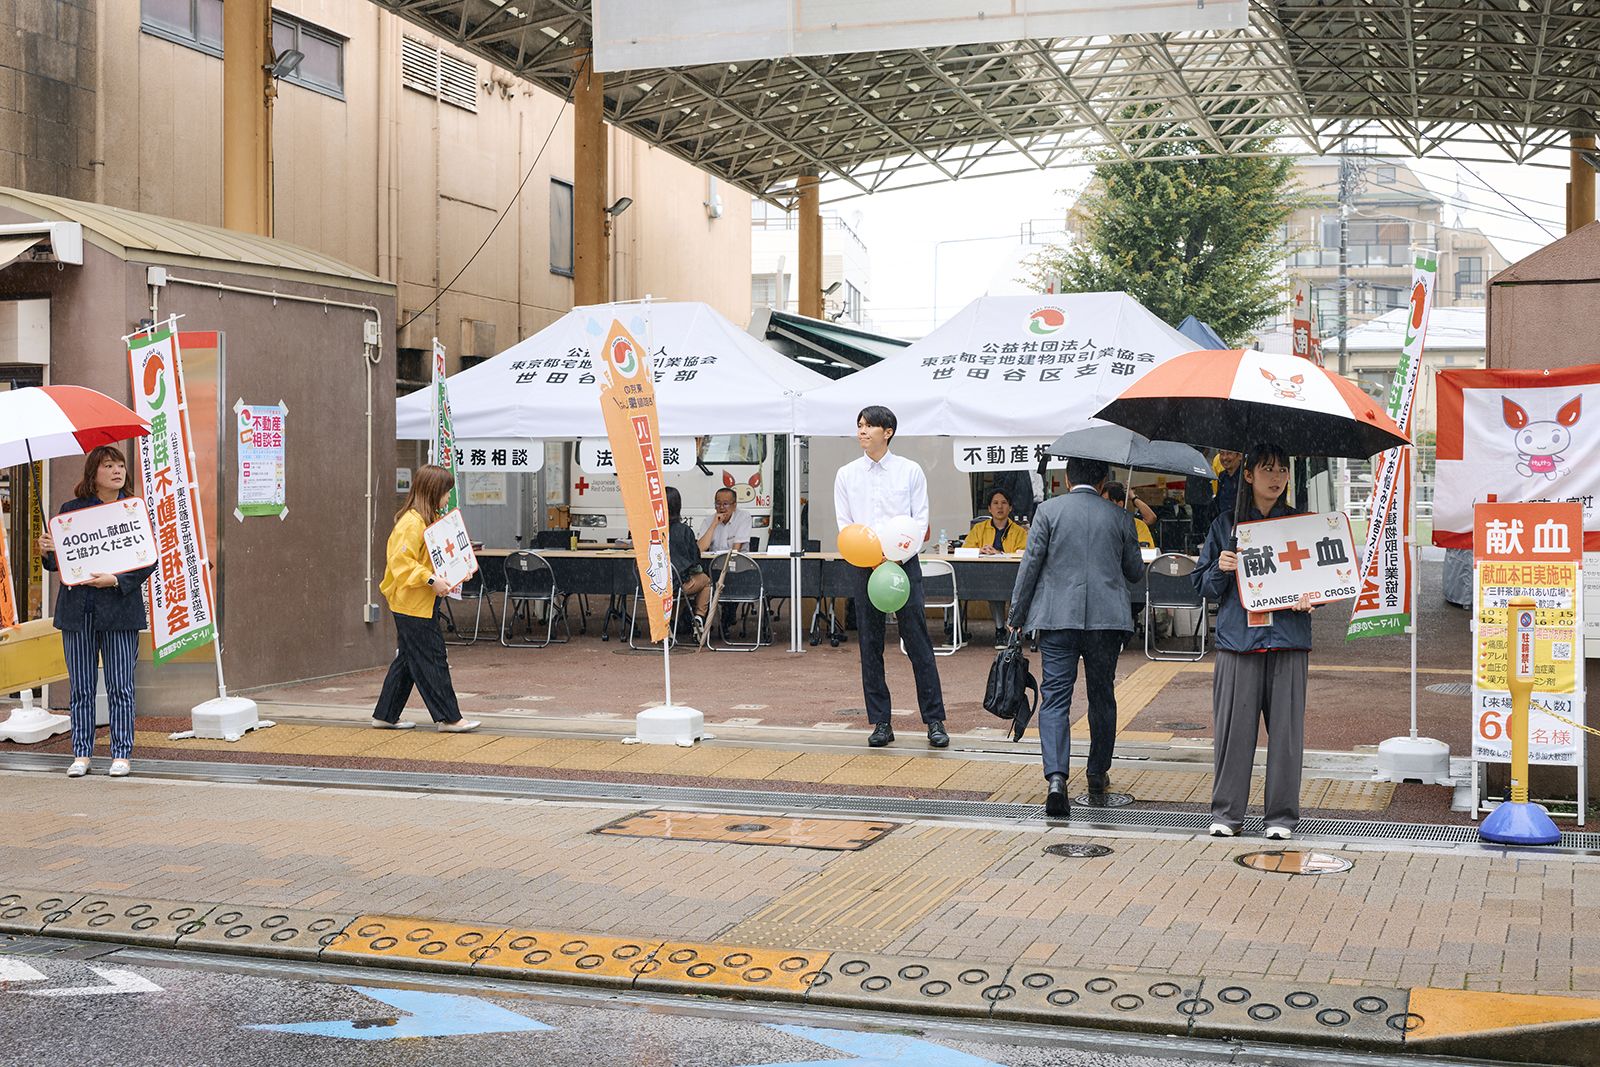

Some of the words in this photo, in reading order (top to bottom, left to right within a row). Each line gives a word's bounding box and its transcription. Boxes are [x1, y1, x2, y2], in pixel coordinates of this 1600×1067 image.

[982, 338, 1097, 354] 公益社団法人
[509, 355, 718, 371] 東京都宅地引業協会
[921, 347, 1155, 367] 東京都宅地建物取引業協会
[515, 370, 698, 384] 世田谷支部
[932, 362, 1136, 382] 世田谷区支部
[252, 415, 282, 431] 不動産
[252, 432, 282, 448] 相談会
[596, 447, 680, 467] 法談
[963, 444, 1068, 465] 不動産相
[755, 495, 771, 507] No.3
[62, 520, 141, 547] 400mL献血に
[1485, 519, 1571, 554] 献血
[65, 534, 145, 561] ご協力ください
[1482, 565, 1572, 586] 献血本日実施中
[1250, 594, 1299, 608] JAPANESE
[1324, 586, 1357, 598] CROSS
[1488, 587, 1567, 598] 三軒茶屋ふれあい広場
[1521, 632, 1530, 674] 駐輪禁止
[1531, 728, 1571, 745] 名様
